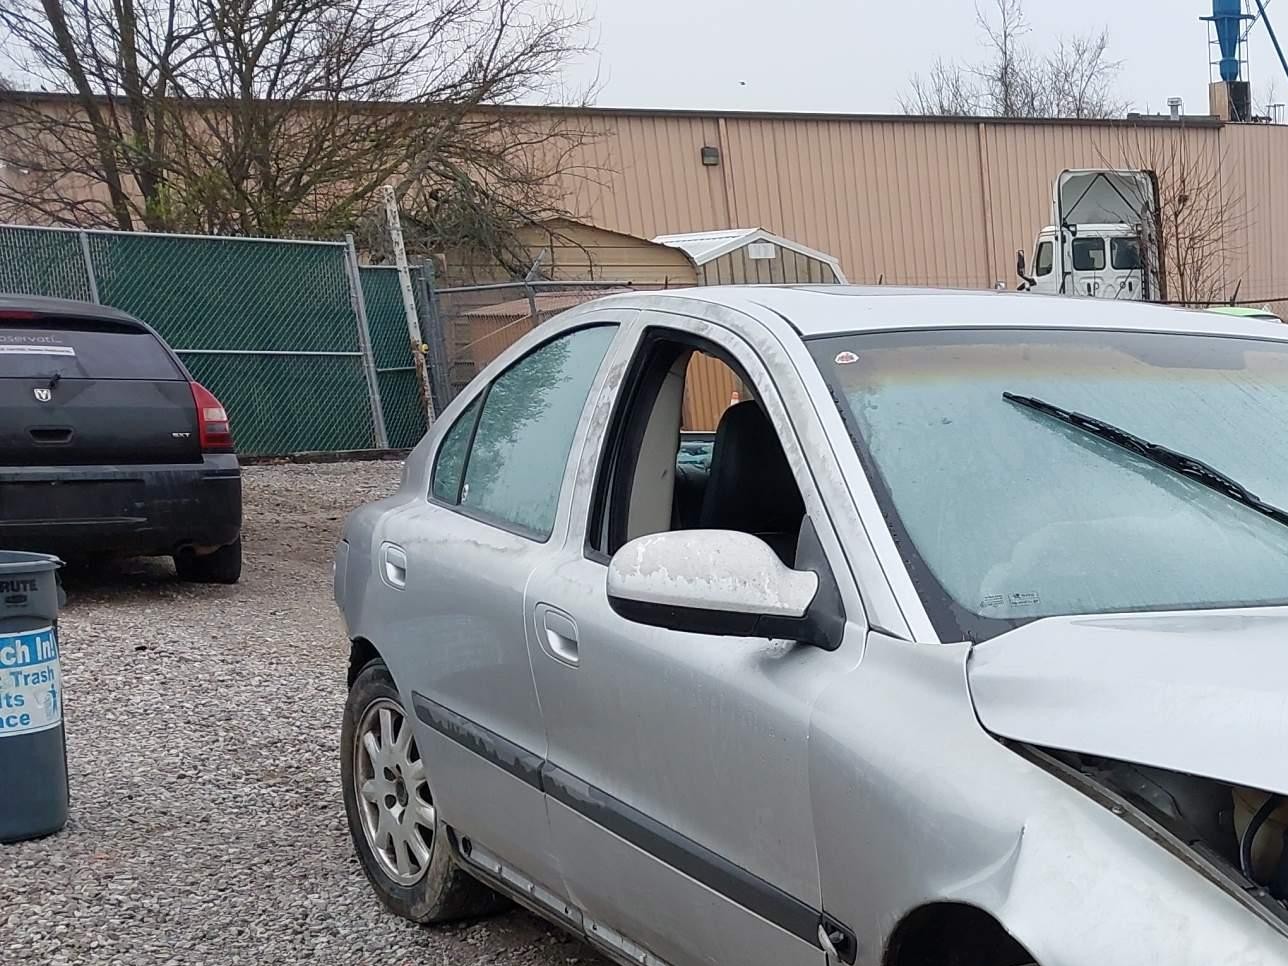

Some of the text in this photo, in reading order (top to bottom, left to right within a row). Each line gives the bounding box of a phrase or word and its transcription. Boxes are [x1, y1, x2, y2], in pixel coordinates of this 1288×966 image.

[0, 633, 56, 666] ch In!
[9, 665, 55, 688] Trash
